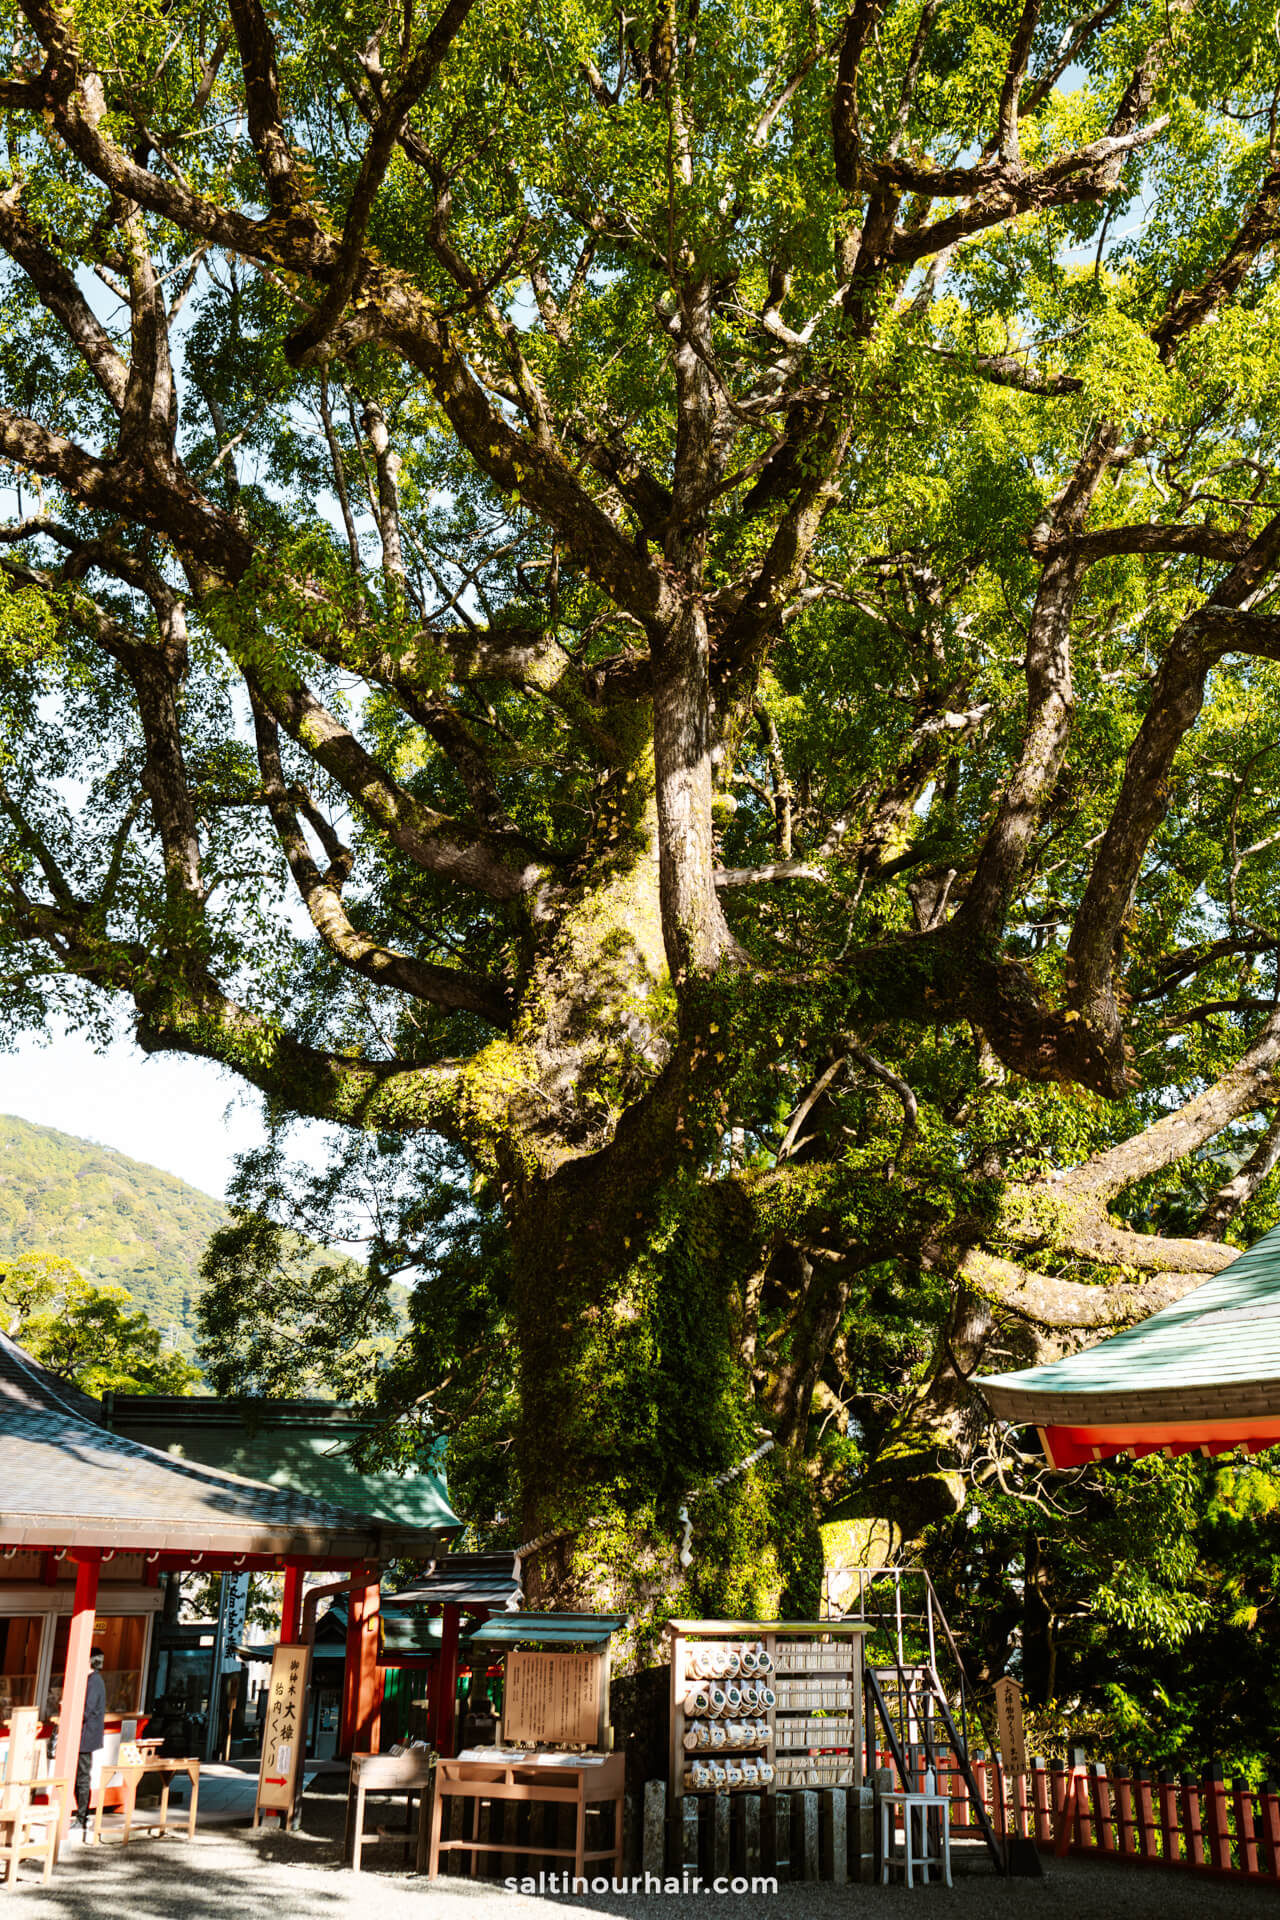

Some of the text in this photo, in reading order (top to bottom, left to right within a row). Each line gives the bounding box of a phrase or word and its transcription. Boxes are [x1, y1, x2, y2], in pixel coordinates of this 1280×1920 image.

[267, 1682, 284, 1768] 胎内くぐり
